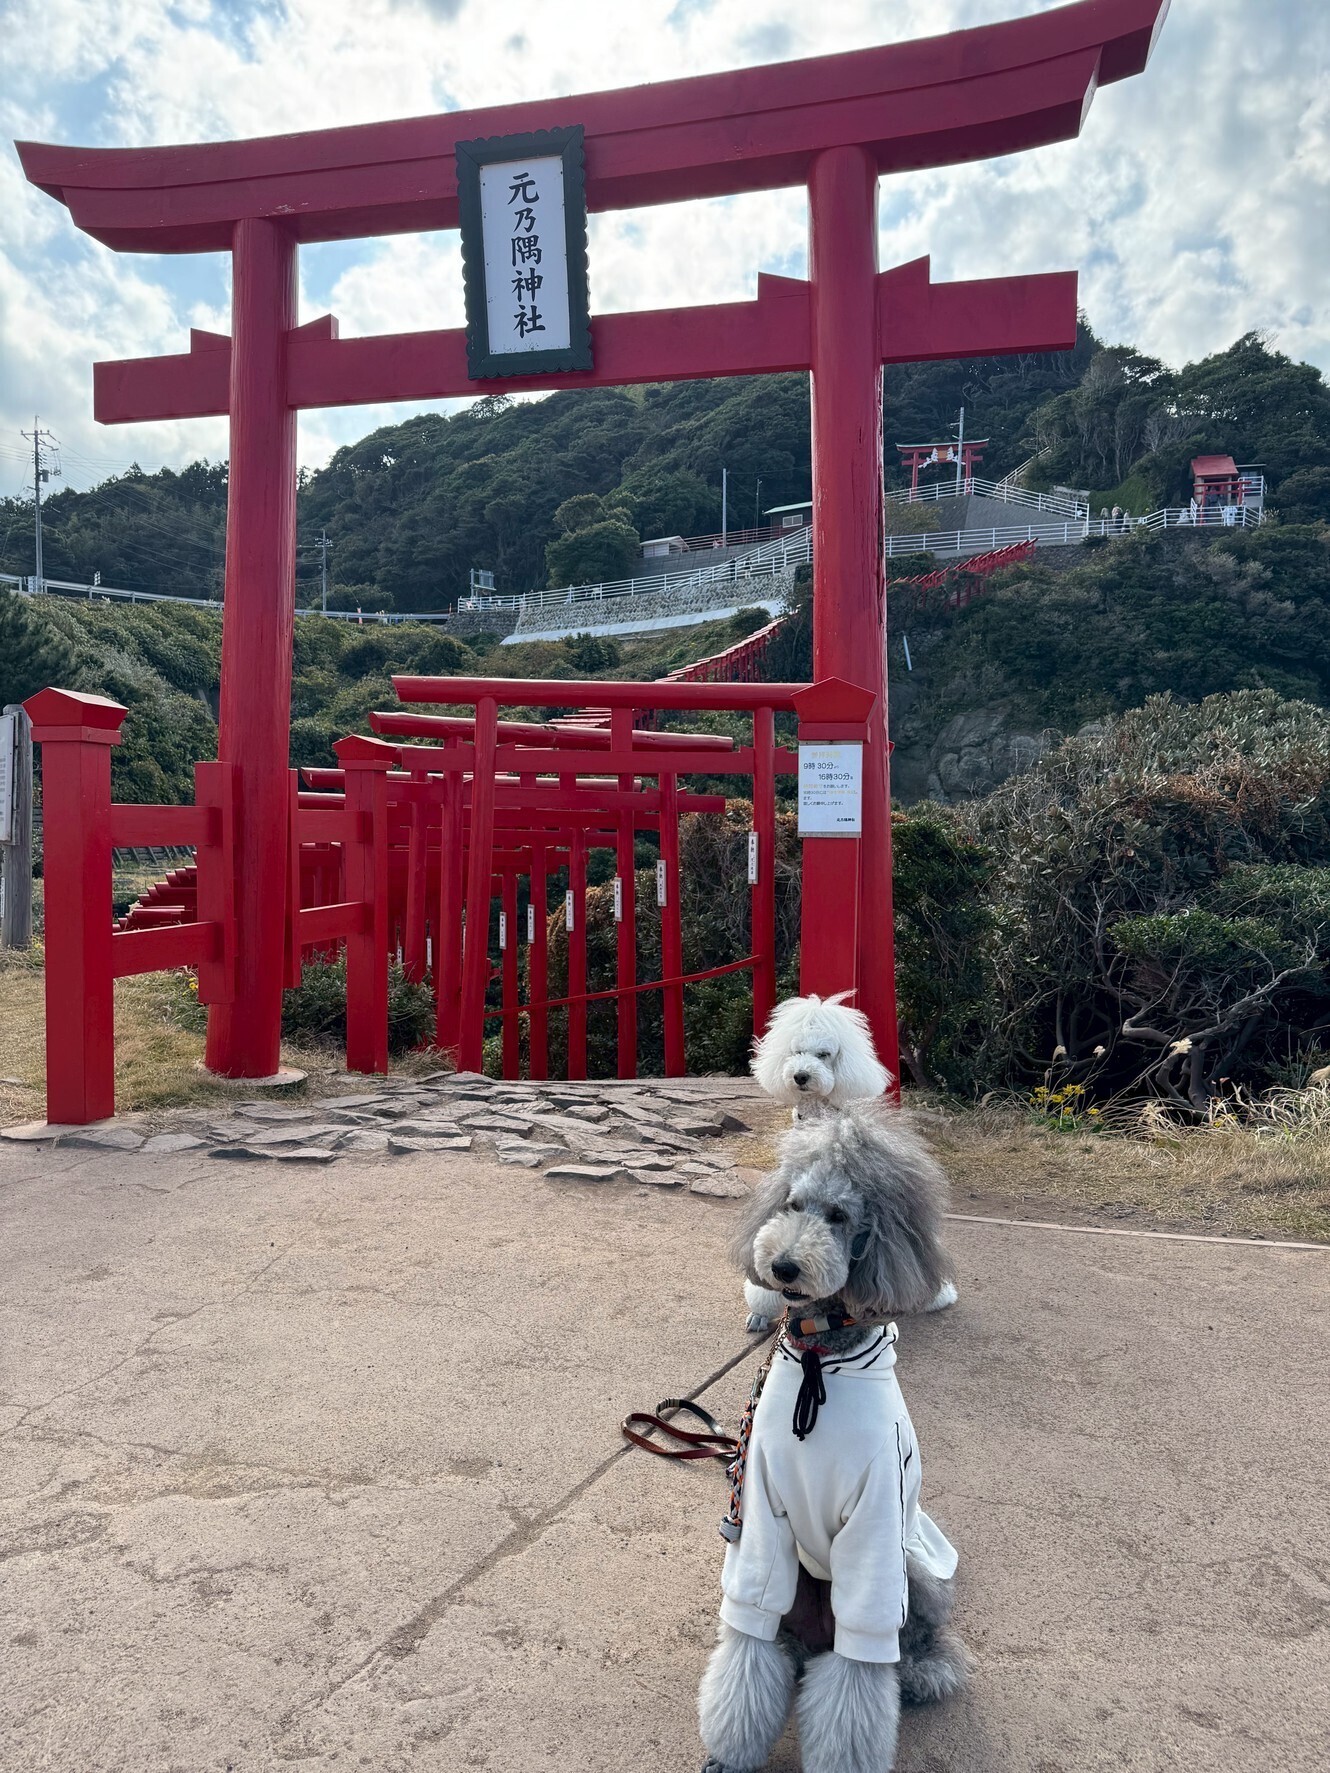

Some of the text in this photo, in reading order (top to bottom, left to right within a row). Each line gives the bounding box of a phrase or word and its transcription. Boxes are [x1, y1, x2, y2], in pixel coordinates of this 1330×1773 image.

[508, 172, 546, 339] 元乃隅神社
[803, 762, 816, 770] 9時
